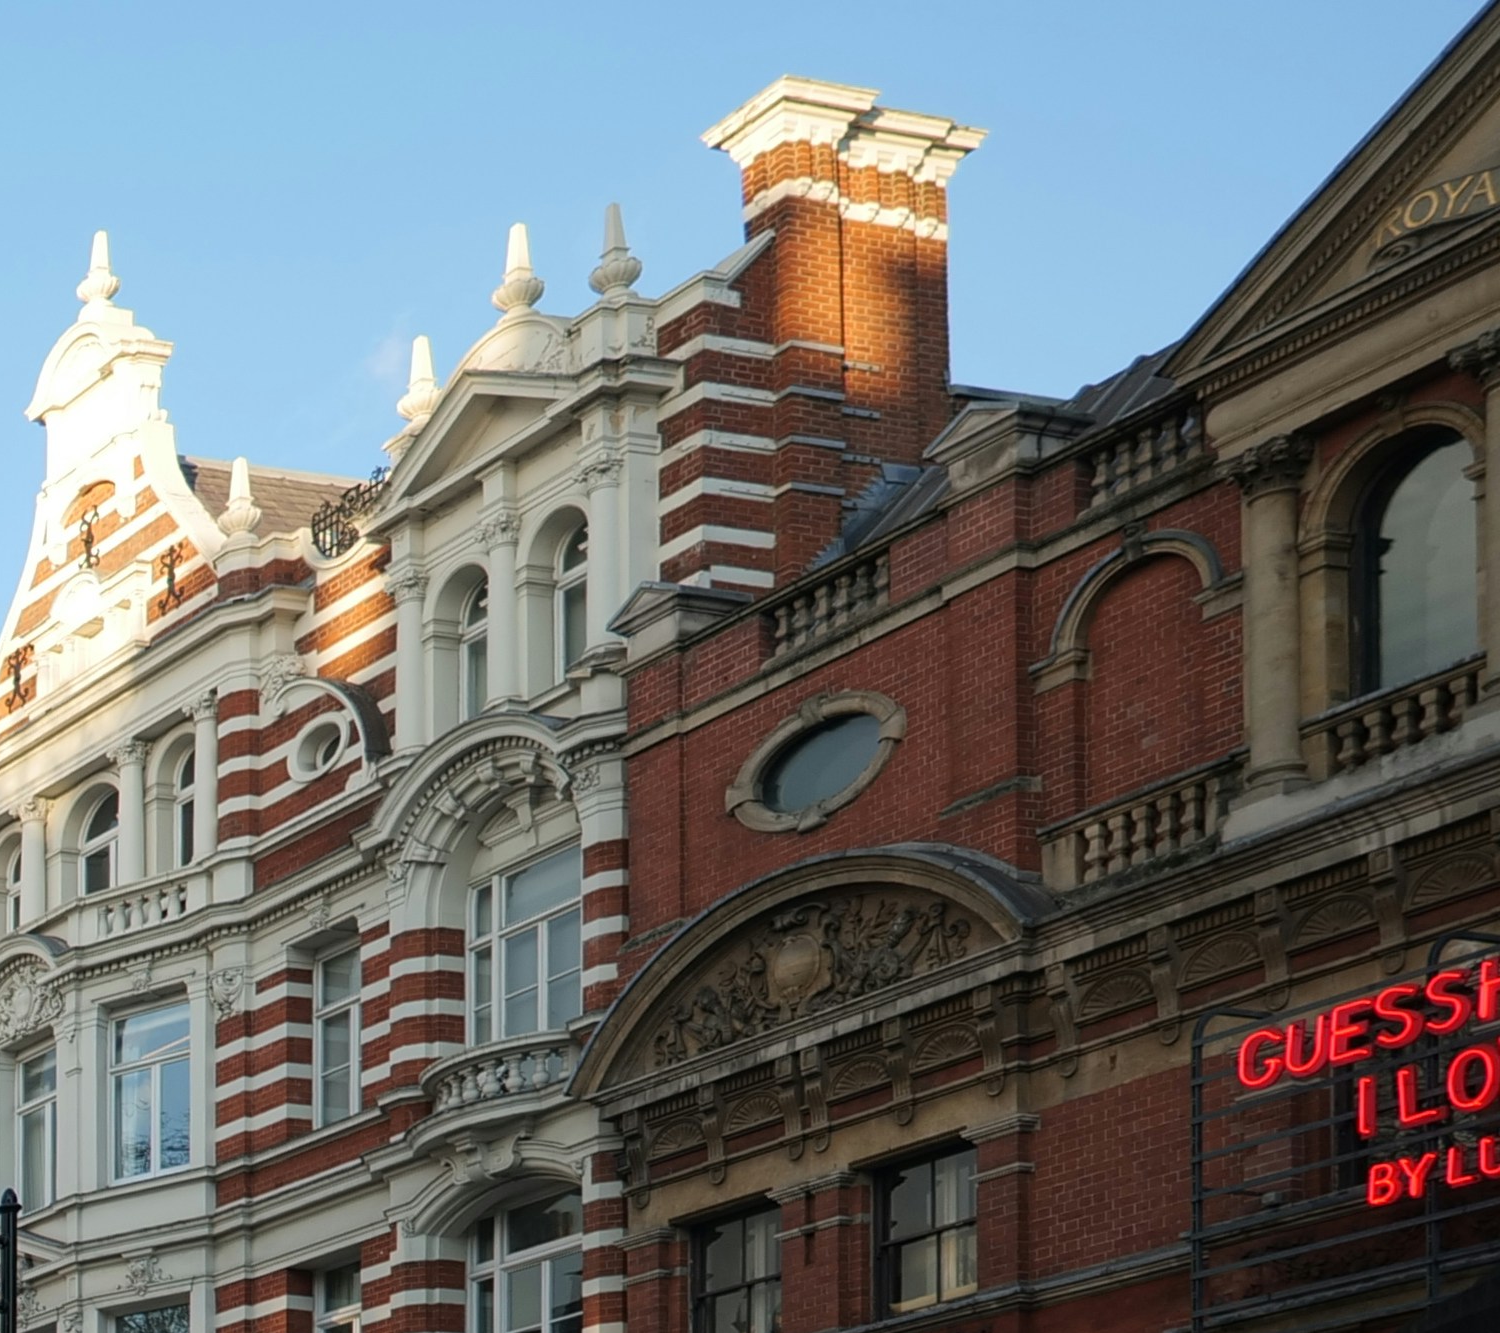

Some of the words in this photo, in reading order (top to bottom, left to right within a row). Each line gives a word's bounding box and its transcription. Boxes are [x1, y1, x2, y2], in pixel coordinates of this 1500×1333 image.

[1238, 967, 1472, 1090] GUESS
[1358, 1075, 1376, 1139] I
[1397, 1038, 1500, 1129] LO
[1367, 1152, 1438, 1205] BY
[1446, 1136, 1500, 1188] LU
